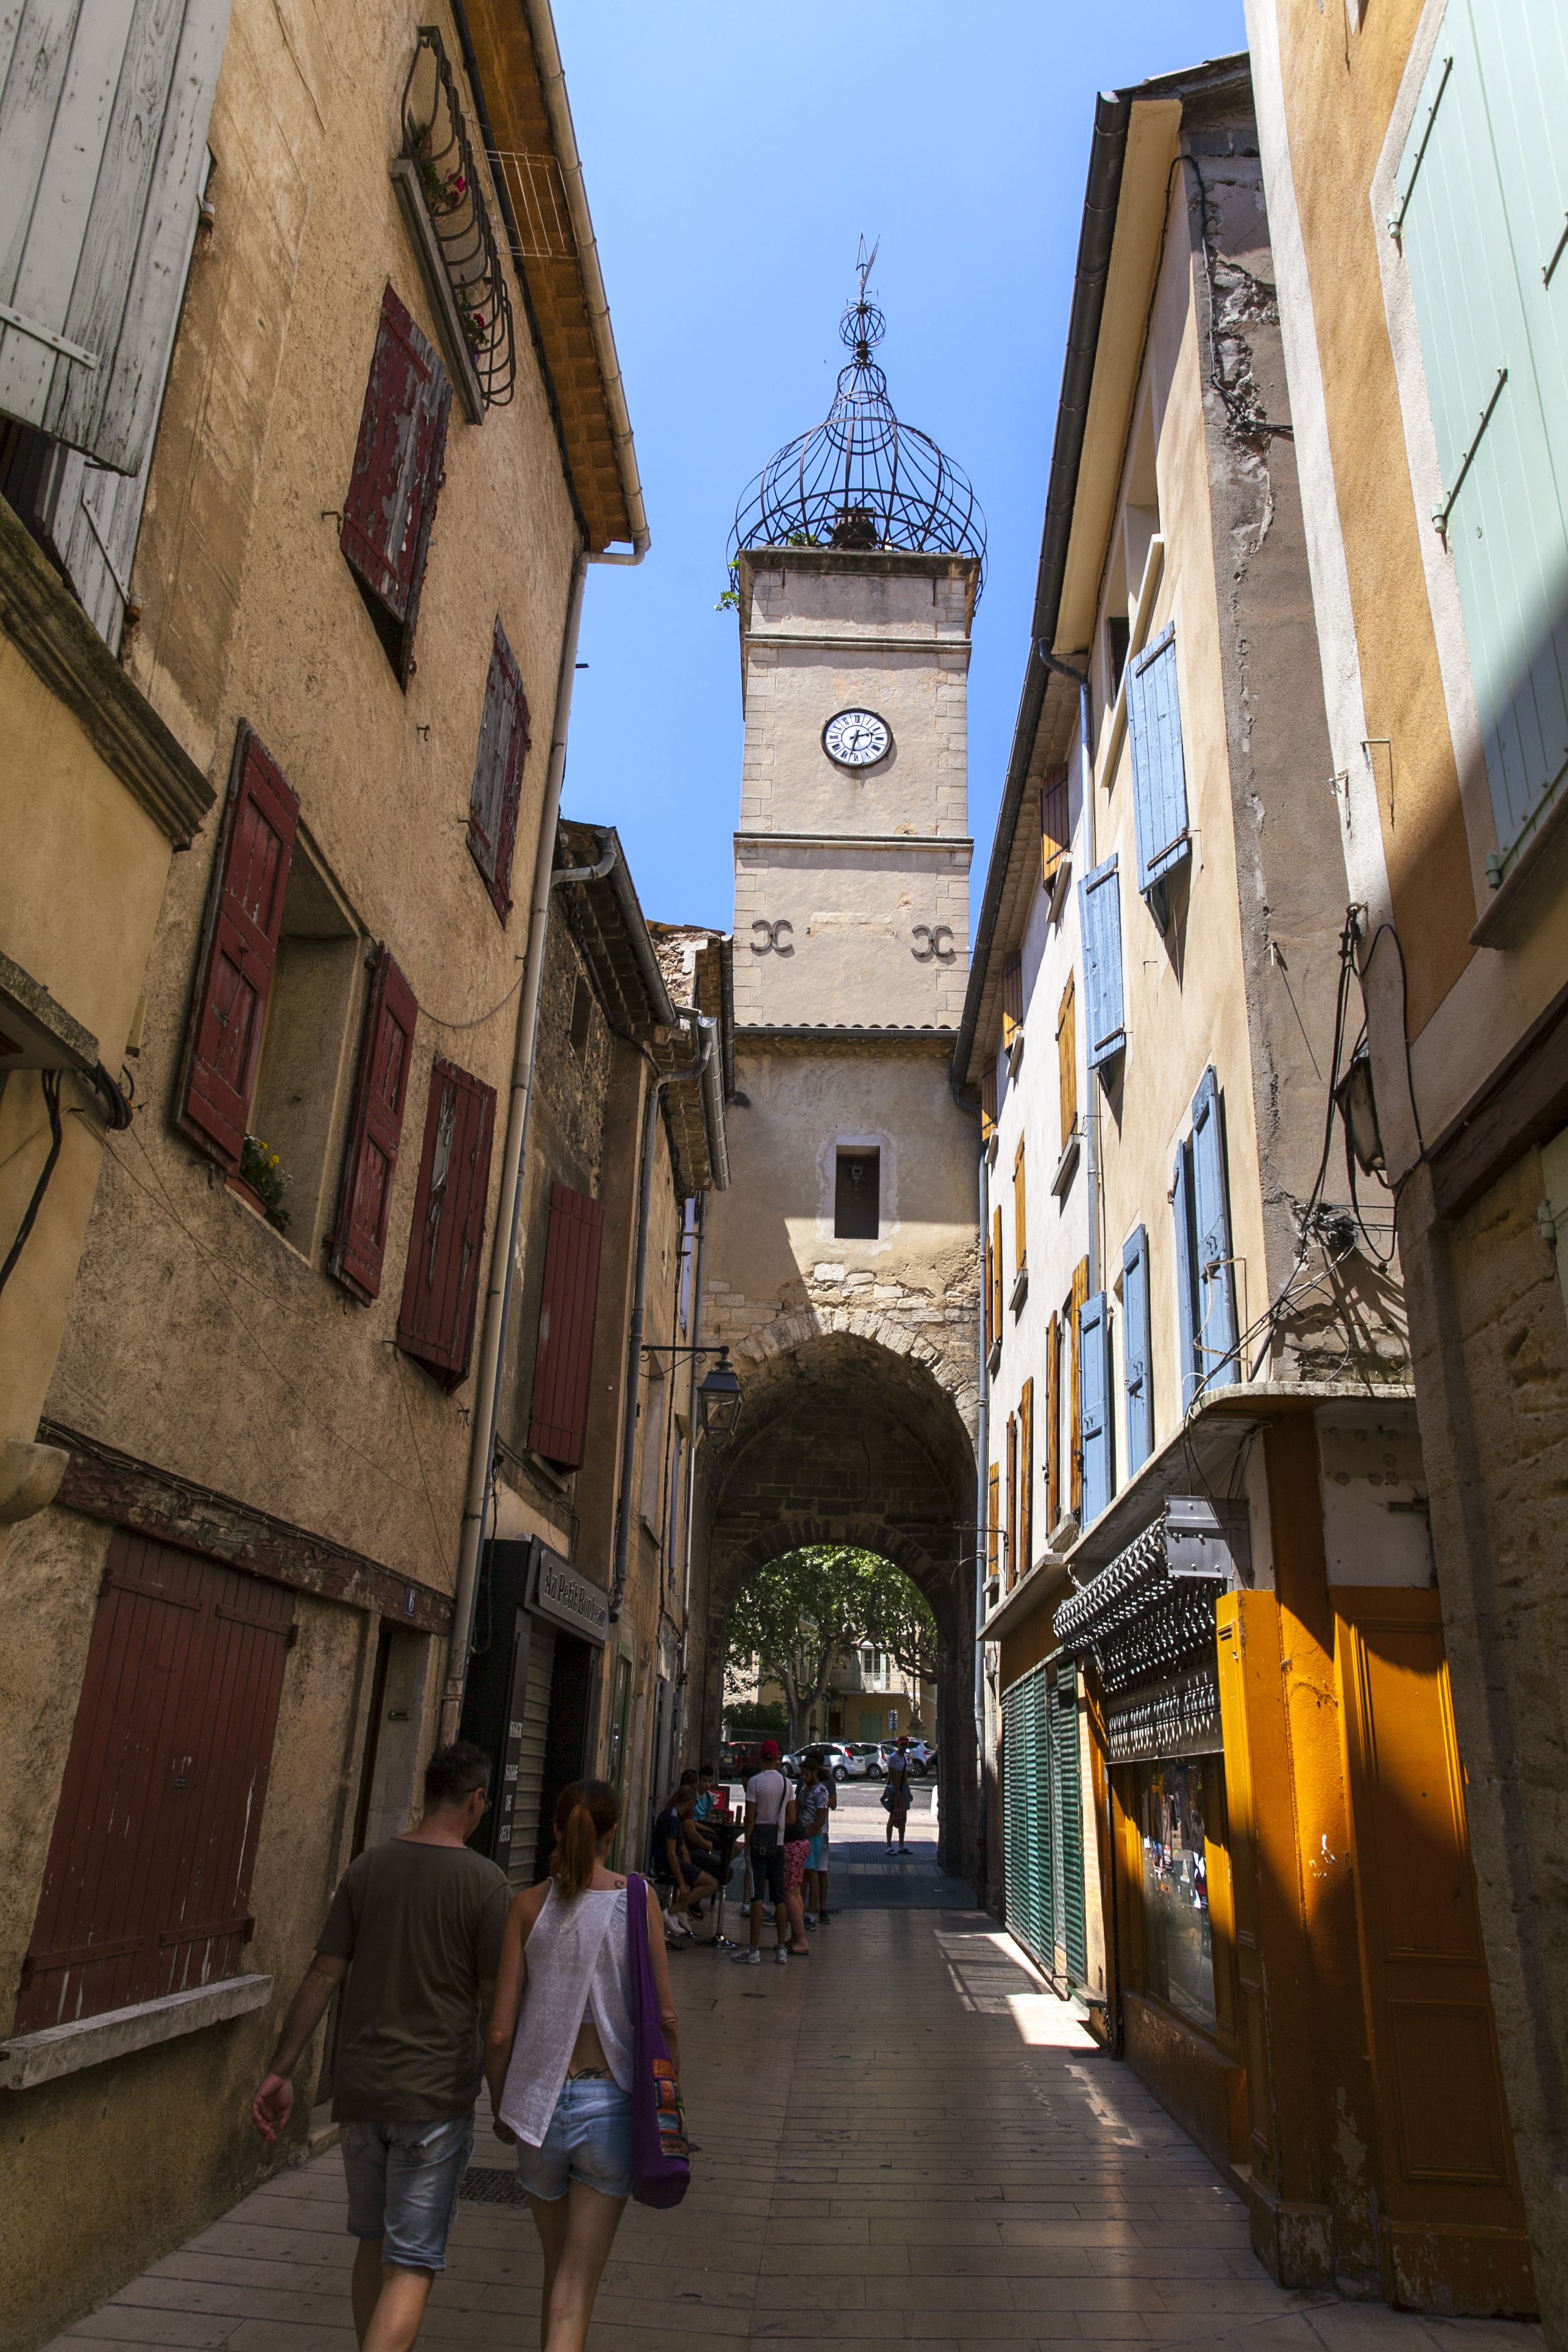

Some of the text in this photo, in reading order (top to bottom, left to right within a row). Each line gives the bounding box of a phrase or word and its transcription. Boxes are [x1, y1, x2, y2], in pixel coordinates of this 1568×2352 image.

[408, 1589, 415, 1612] 6
[544, 1564, 607, 1630] Au Petit Bonheur
[509, 1721, 523, 1739] SNACK
[505, 1764, 518, 1781] SALLE
[505, 1795, 512, 1812] DE
[500, 1825, 511, 1843] JEUX
